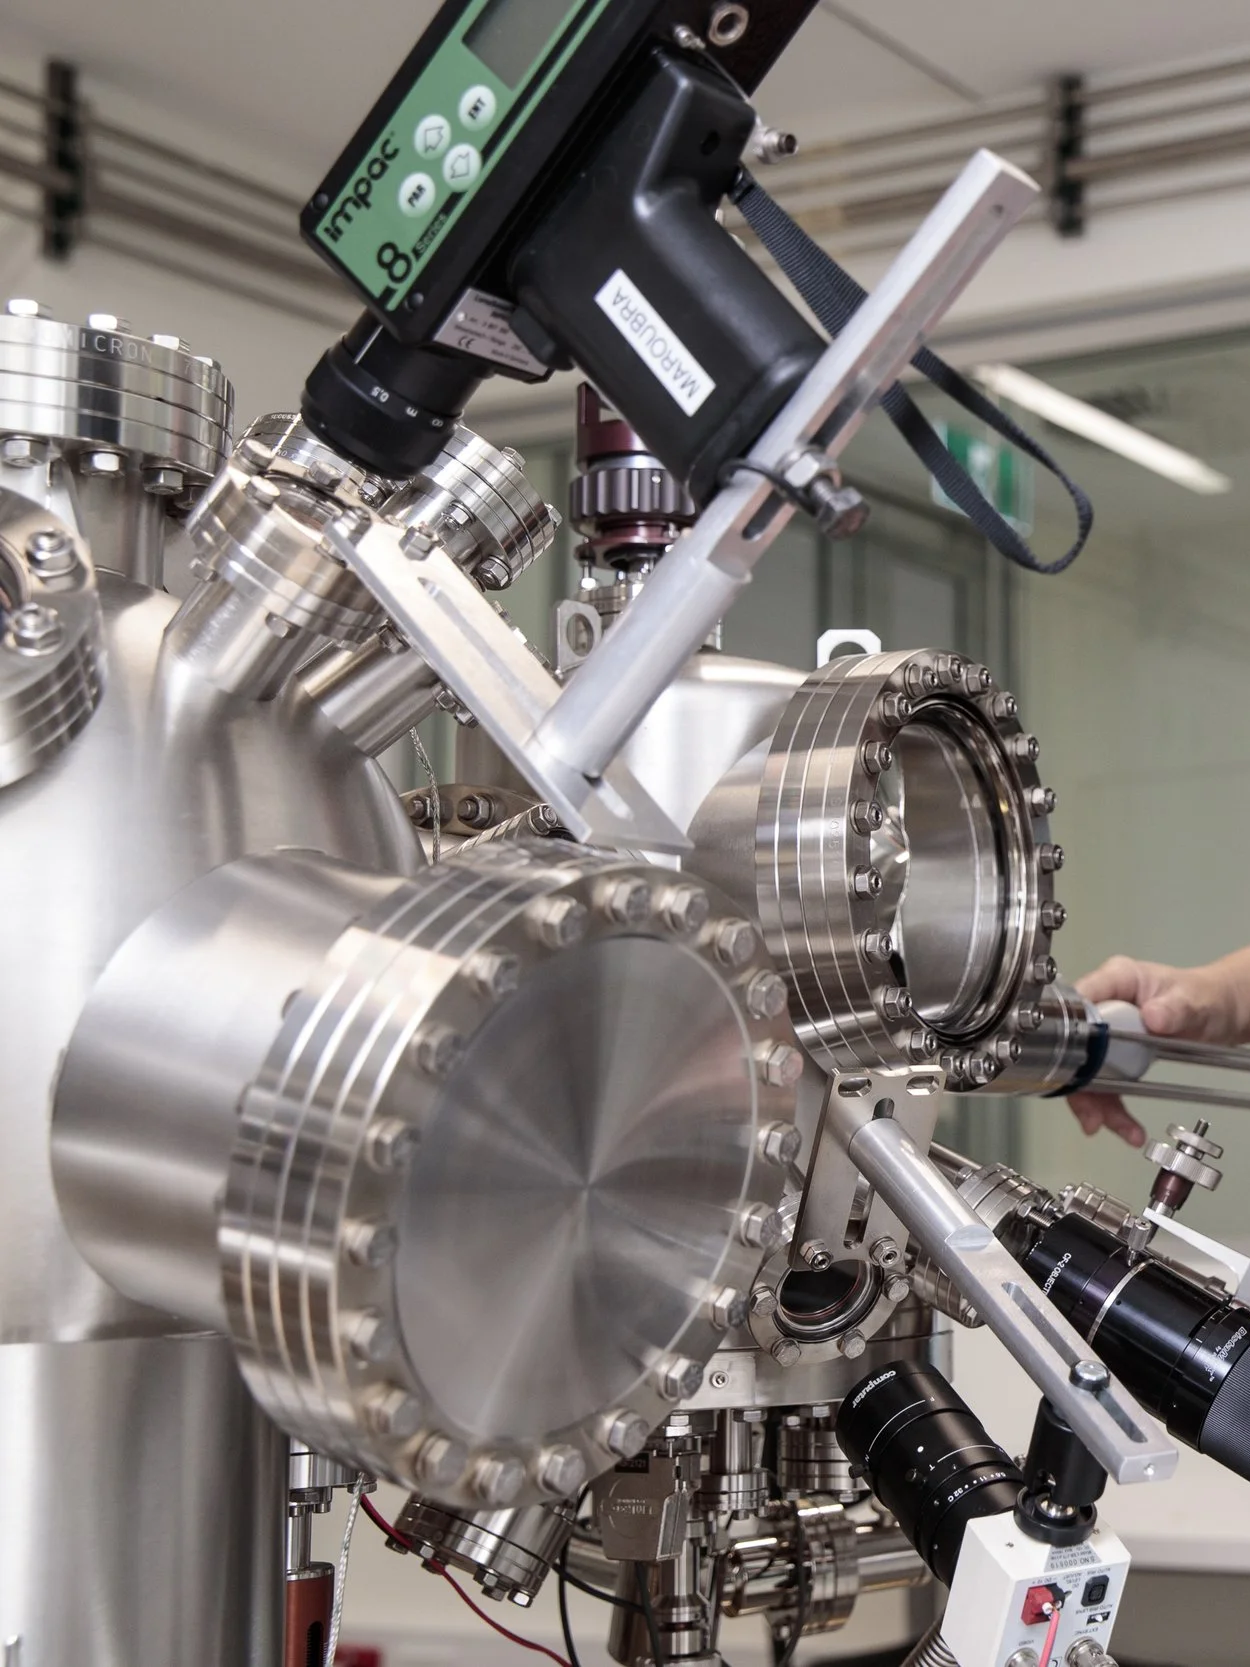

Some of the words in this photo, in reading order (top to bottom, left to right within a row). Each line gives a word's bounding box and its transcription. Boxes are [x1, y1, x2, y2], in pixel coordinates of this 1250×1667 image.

[467, 96, 487, 120] ENT
[323, 138, 400, 243] impac
[407, 183, 426, 208] PAR
[376, 241, 413, 284] 8
[611, 286, 701, 399] MAROUBRA
[1056, 1252, 1072, 1268] CF-2
[851, 1369, 897, 1409] computar
[953, 1488, 964, 1498] 32
